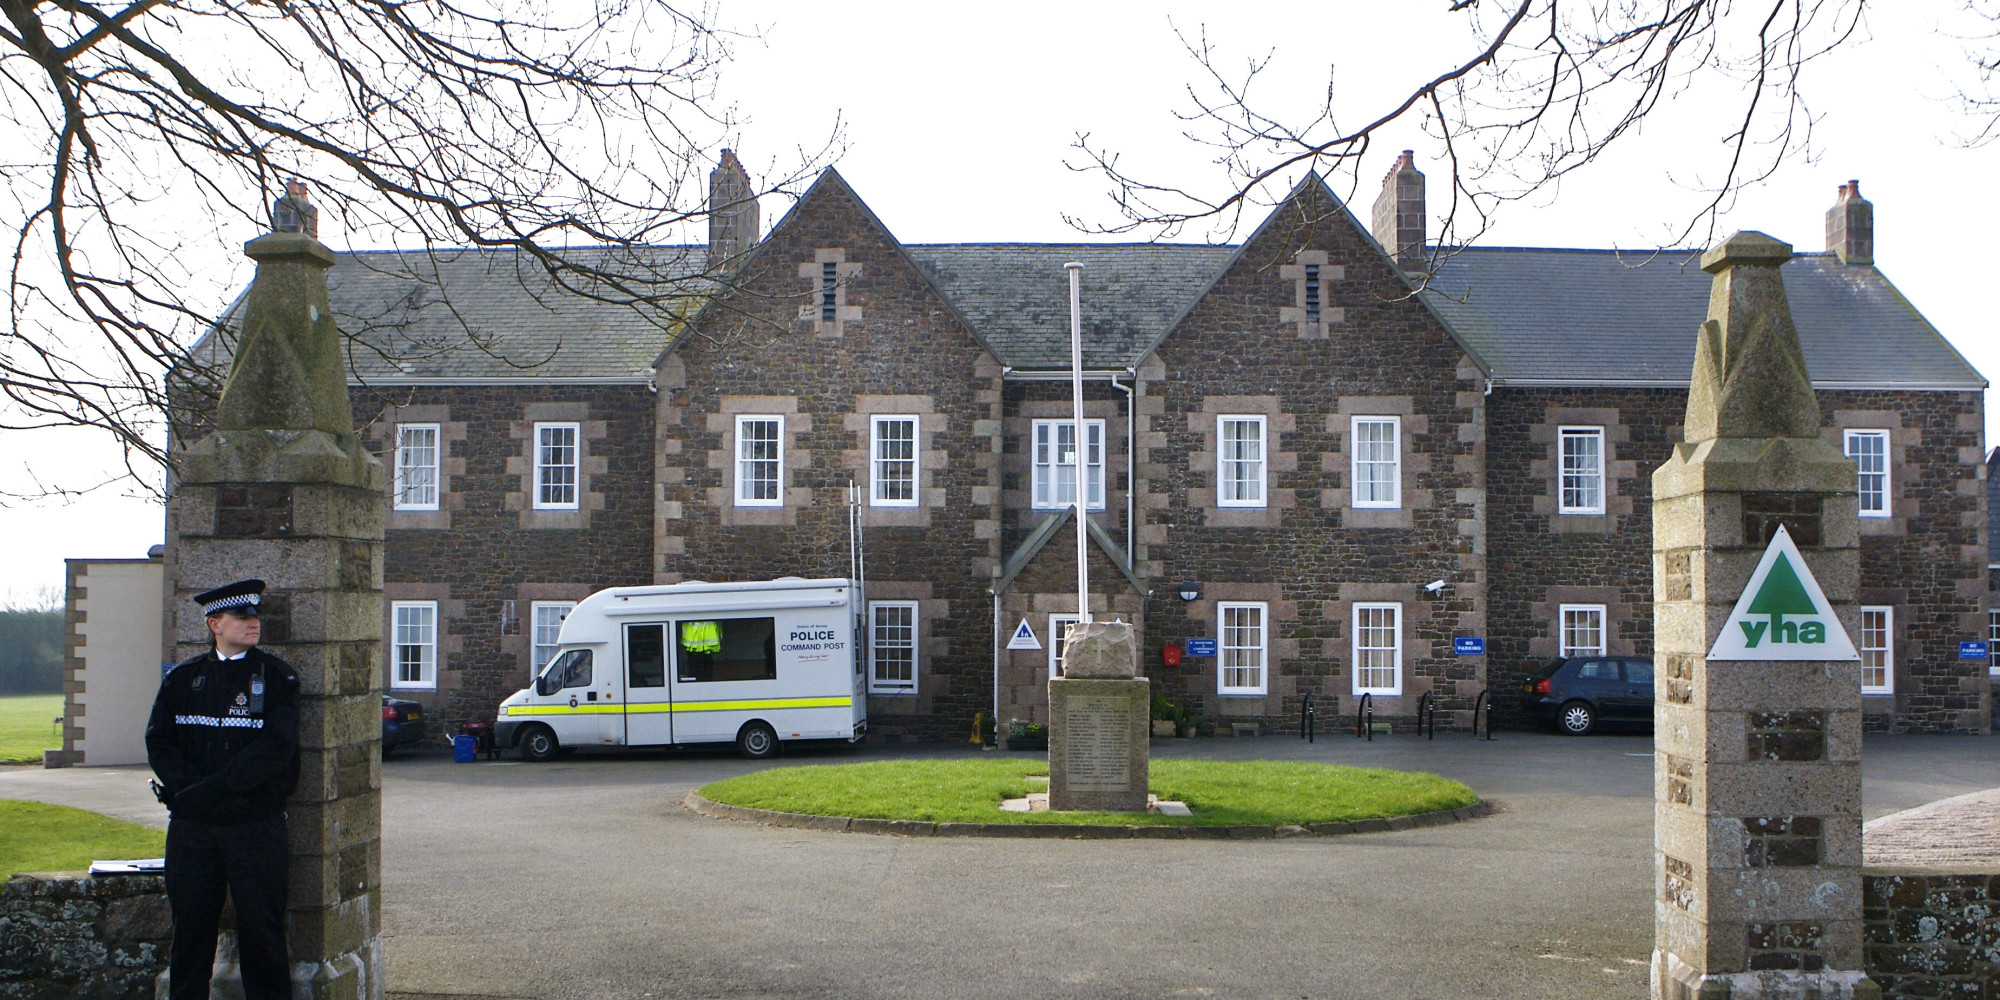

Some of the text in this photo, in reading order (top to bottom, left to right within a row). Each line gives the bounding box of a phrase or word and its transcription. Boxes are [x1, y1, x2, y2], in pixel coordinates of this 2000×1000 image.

[1738, 613, 1826, 649] yha
[790, 631, 835, 641] POLICE
[781, 642, 845, 651] COMMAND POST
[229, 708, 250, 716] POLIC
